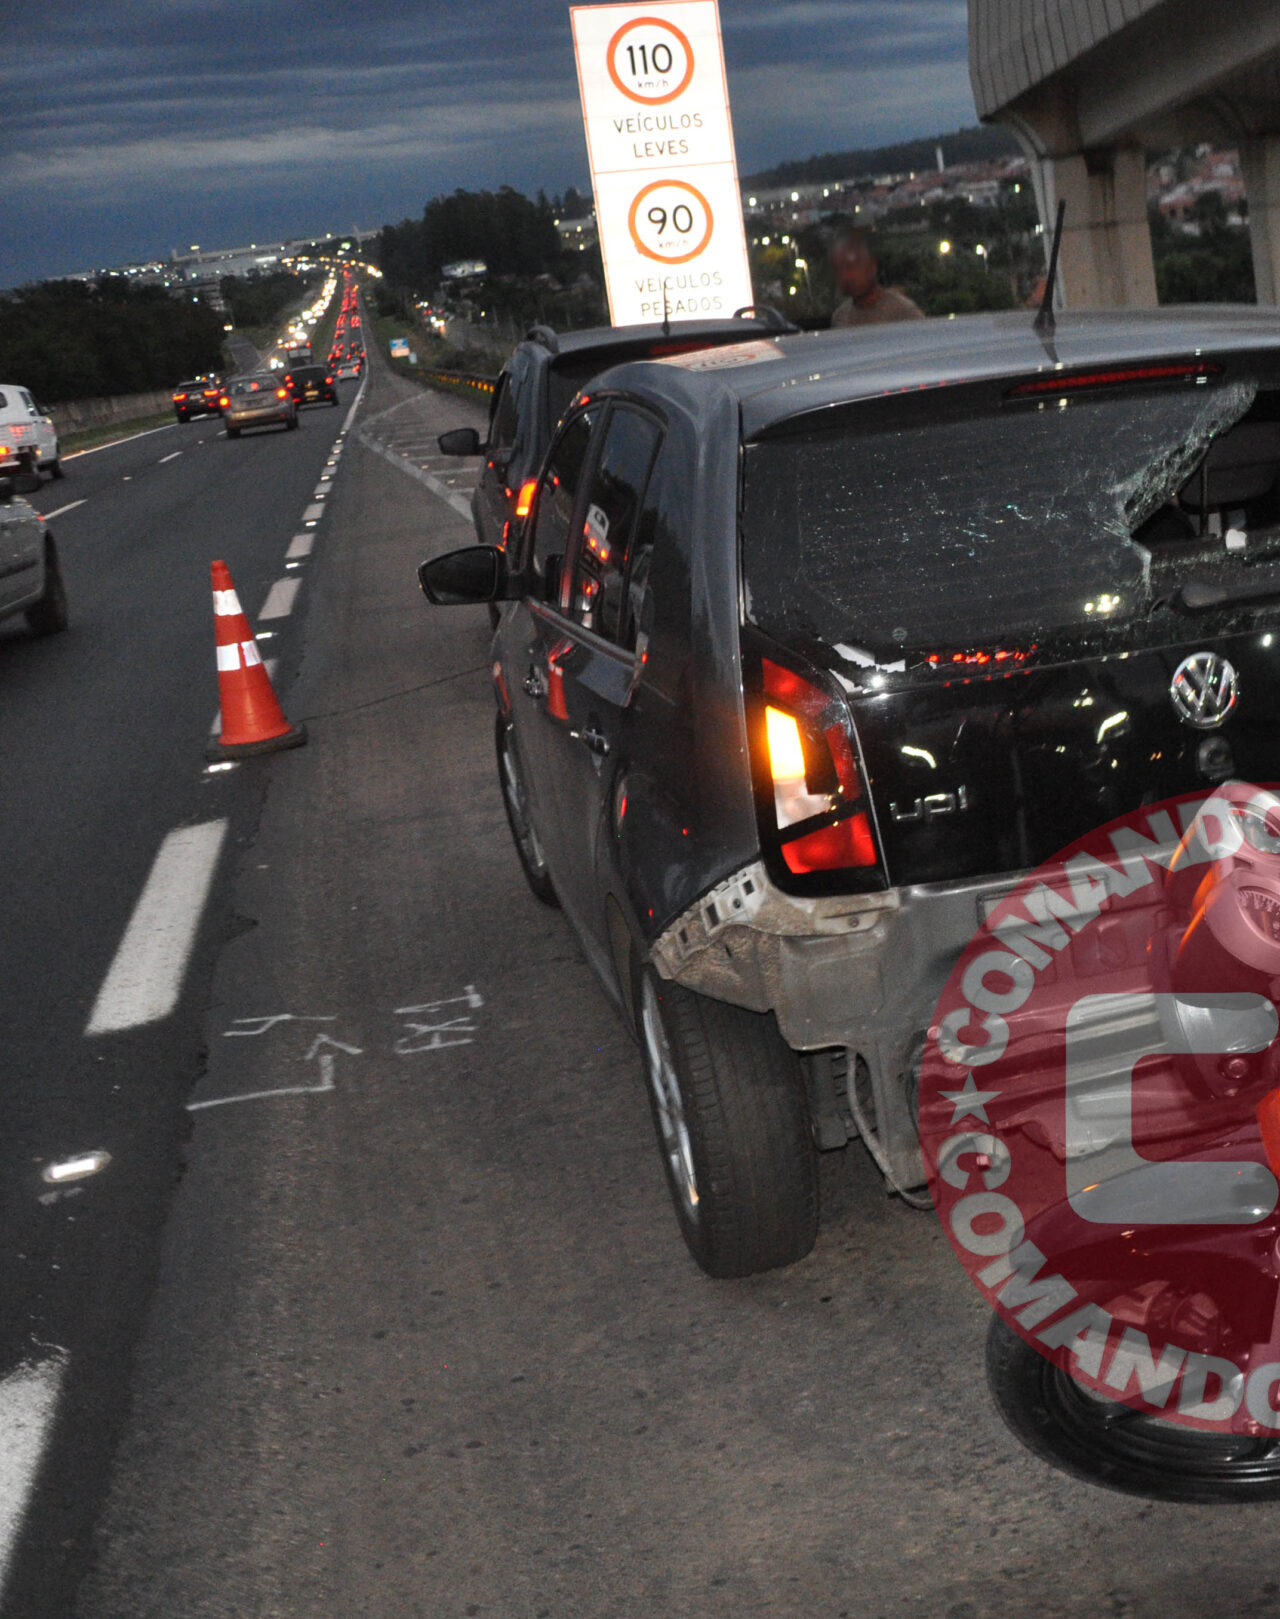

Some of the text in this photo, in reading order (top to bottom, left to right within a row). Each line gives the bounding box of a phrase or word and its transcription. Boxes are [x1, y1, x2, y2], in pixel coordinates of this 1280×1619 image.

[626, 43, 673, 76] 110
[613, 111, 704, 134] VEÍCULOS
[633, 139, 689, 159] LEVES
[647, 204, 693, 235] 90
[641, 295, 723, 317] PESADOS
